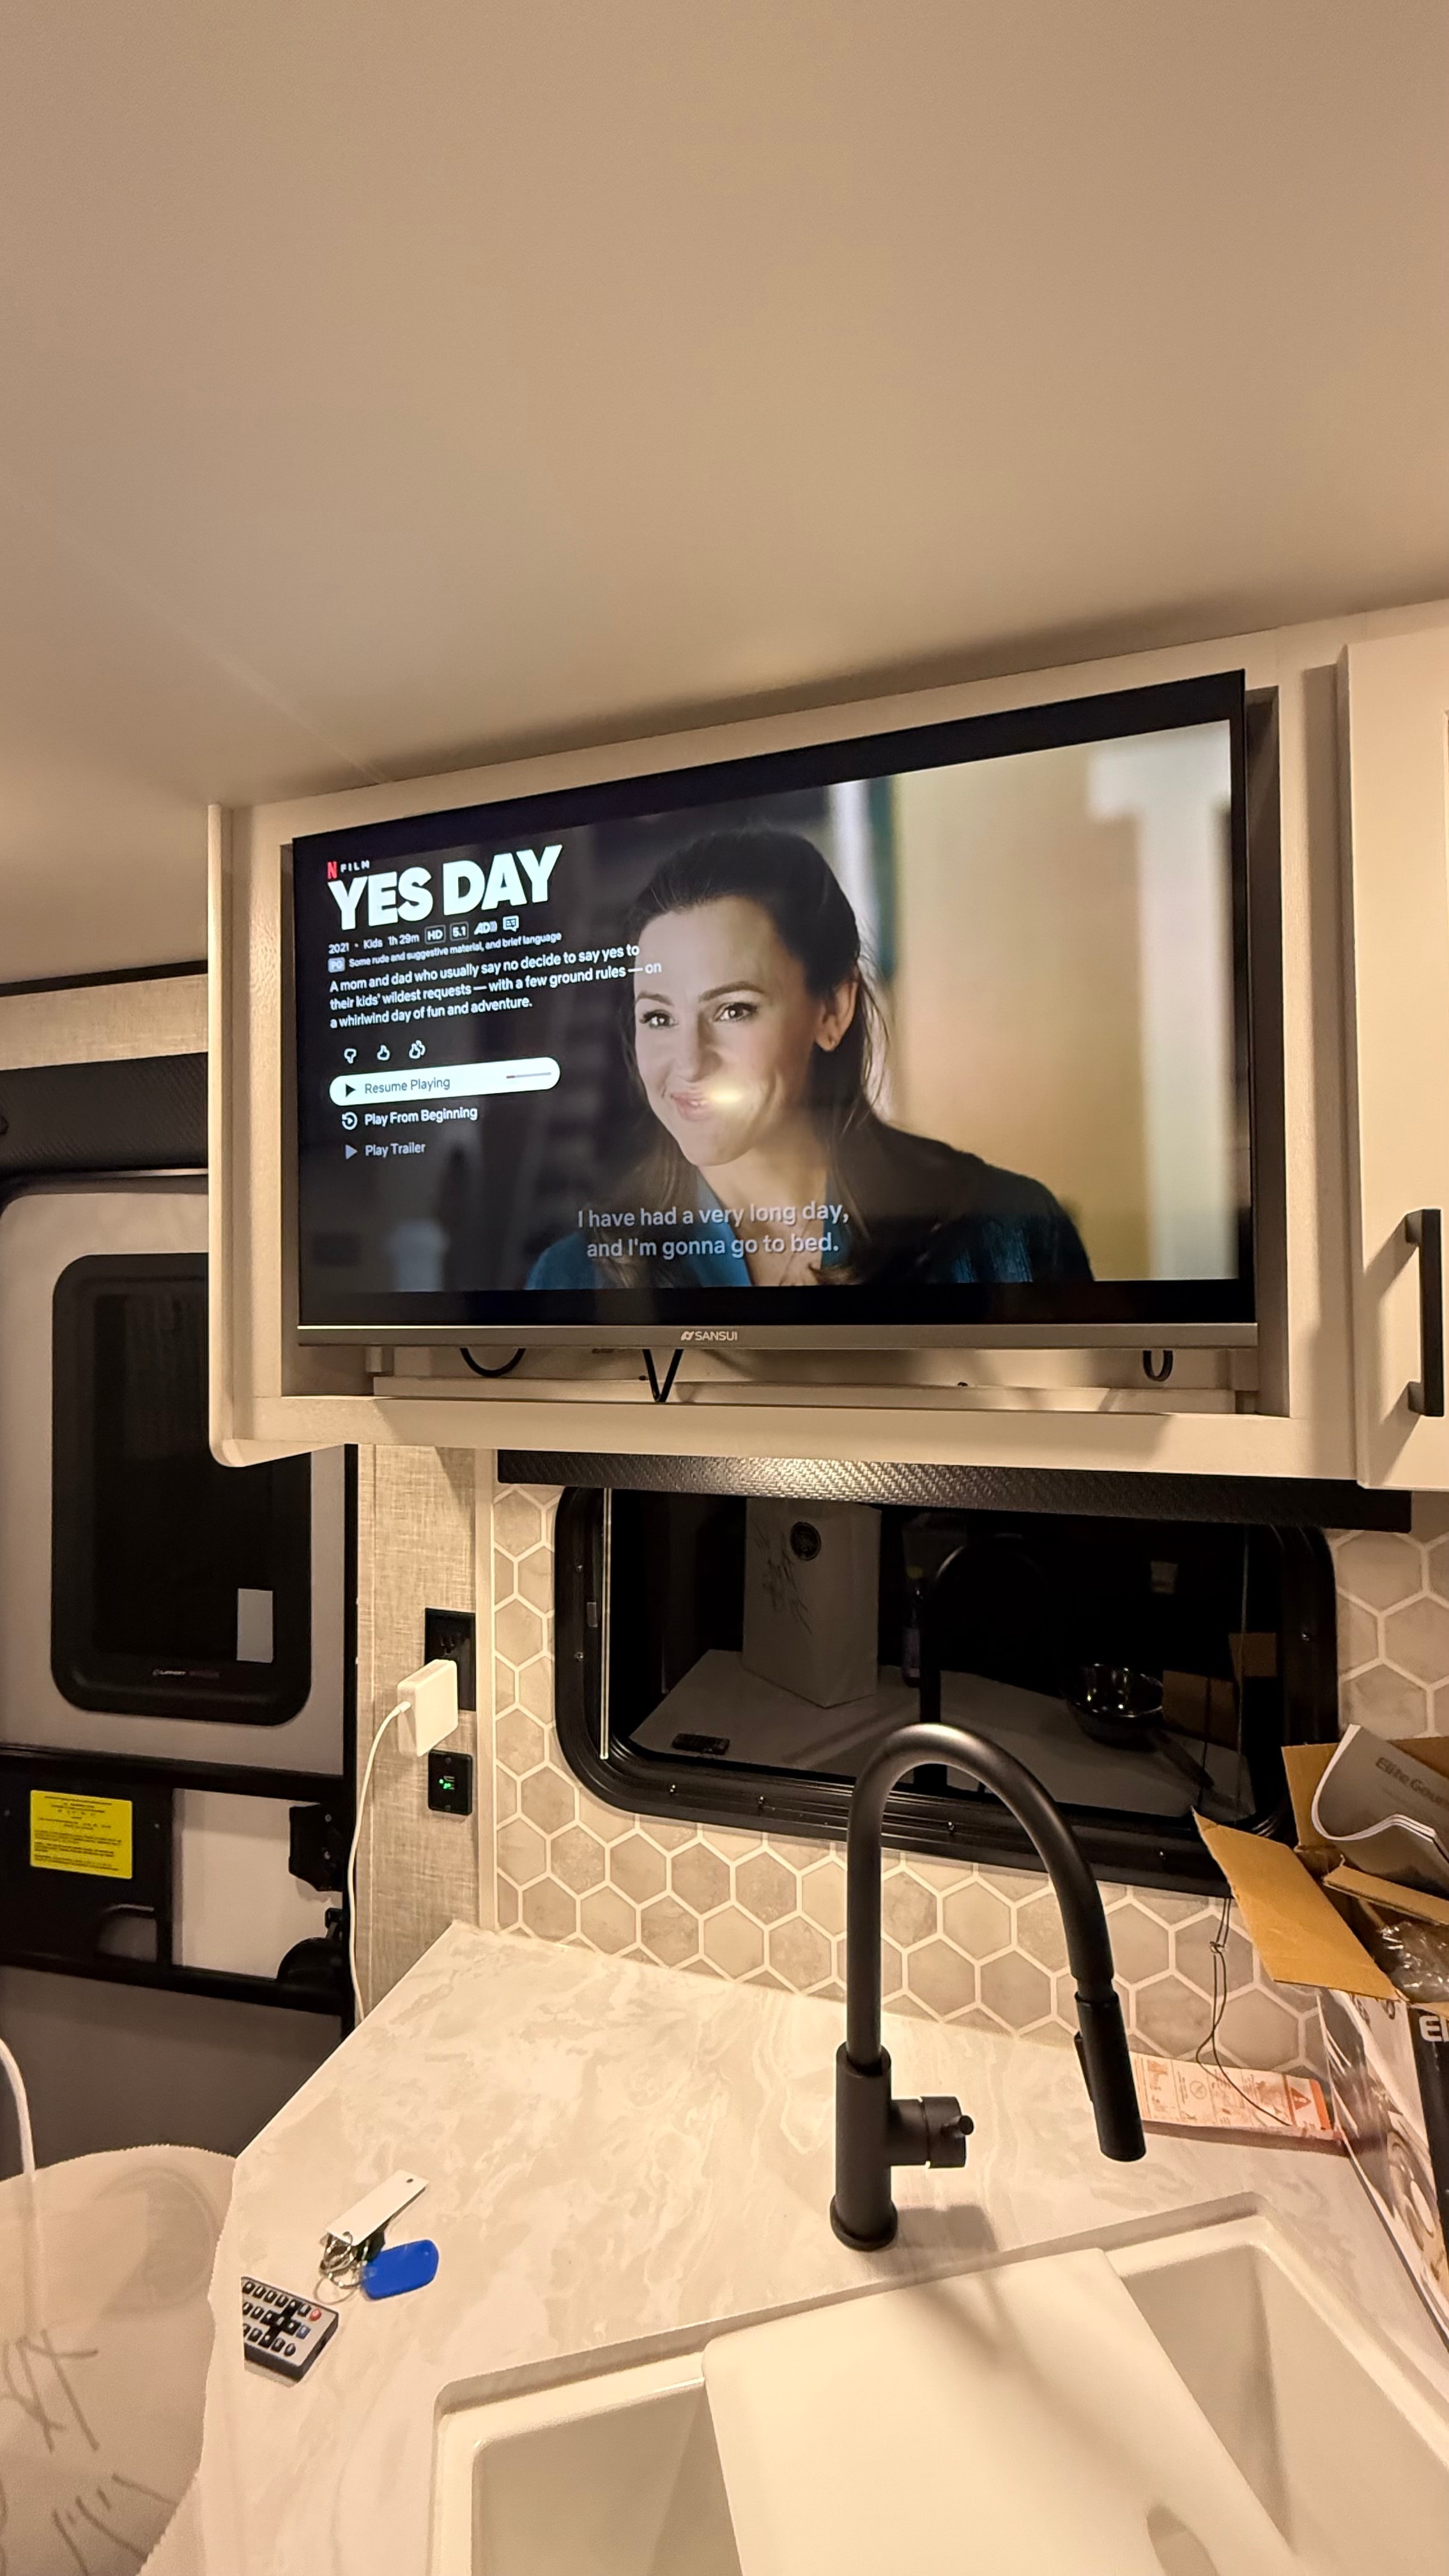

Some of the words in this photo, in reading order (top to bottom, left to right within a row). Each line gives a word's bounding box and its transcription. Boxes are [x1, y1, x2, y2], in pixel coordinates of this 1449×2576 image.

[340, 860, 370, 873] FILM
[327, 867, 434, 930] YES
[443, 844, 563, 916] DAY
[328, 942, 349, 954] 2021
[363, 938, 383, 950] Kids
[388, 935, 398, 946] 1h
[399, 933, 420, 946] 29m
[427, 930, 443, 941] HD
[452, 926, 466, 938] 5.1
[348, 958, 371, 969] Some
[372, 954, 389, 965] rude
[390, 951, 406, 962] and
[406, 946, 448, 961] suggestive
[485, 939, 501, 950] and
[502, 935, 521, 947] brief
[522, 931, 562, 946] language
[330, 981, 339, 993] A
[340, 978, 367, 990] mom
[369, 974, 390, 986] and
[391, 971, 413, 984] dad
[414, 968, 438, 982] who
[440, 963, 479, 980] usually
[480, 961, 502, 976] say
[503, 960, 519, 972] no
[520, 952, 561, 969] decide
[563, 951, 576, 964] to
[578, 949, 600, 963] say
[602, 946, 624, 962] yes
[626, 943, 640, 956] to
[330, 997, 355, 1011] their
[382, 987, 421, 1005] wildest
[422, 983, 472, 1001] requests
[488, 977, 514, 993] with
[515, 979, 523, 989] a
[525, 974, 547, 988] few
[549, 969, 594, 988] ground
[595, 965, 627, 981] rules
[645, 962, 662, 975] on
[330, 1017, 338, 1029] a
[339, 1011, 390, 1028] whirlwind
[391, 1008, 411, 1023] day
[413, 1007, 424, 1020] of
[426, 1004, 445, 1018] fun
[447, 1001, 470, 1015] and
[470, 995, 533, 1014] adventure.
[365, 1081, 408, 1094] Resume
[410, 1077, 450, 1092] Playing
[364, 1114, 388, 1127] Play
[390, 1110, 419, 1124] From
[420, 1106, 478, 1123] Beginning
[365, 1144, 388, 1158] Play
[390, 1140, 426, 1155] Trailer
[578, 1211, 583, 1228] I
[588, 1210, 635, 1227] have
[640, 1207, 677, 1225] had
[682, 1209, 694, 1225] a
[699, 1209, 744, 1227] very
[749, 1204, 796, 1225] long
[802, 1200, 849, 1223] day,
[586, 1238, 623, 1258] and
[628, 1238, 657, 1257] I'm
[662, 1238, 726, 1261] gonna
[731, 1238, 758, 1259] go
[763, 1234, 785, 1253] to
[790, 1232, 839, 1253] bed.
[694, 1331, 737, 1342] SANSUI
[1376, 1757, 1409, 1784] Elite
